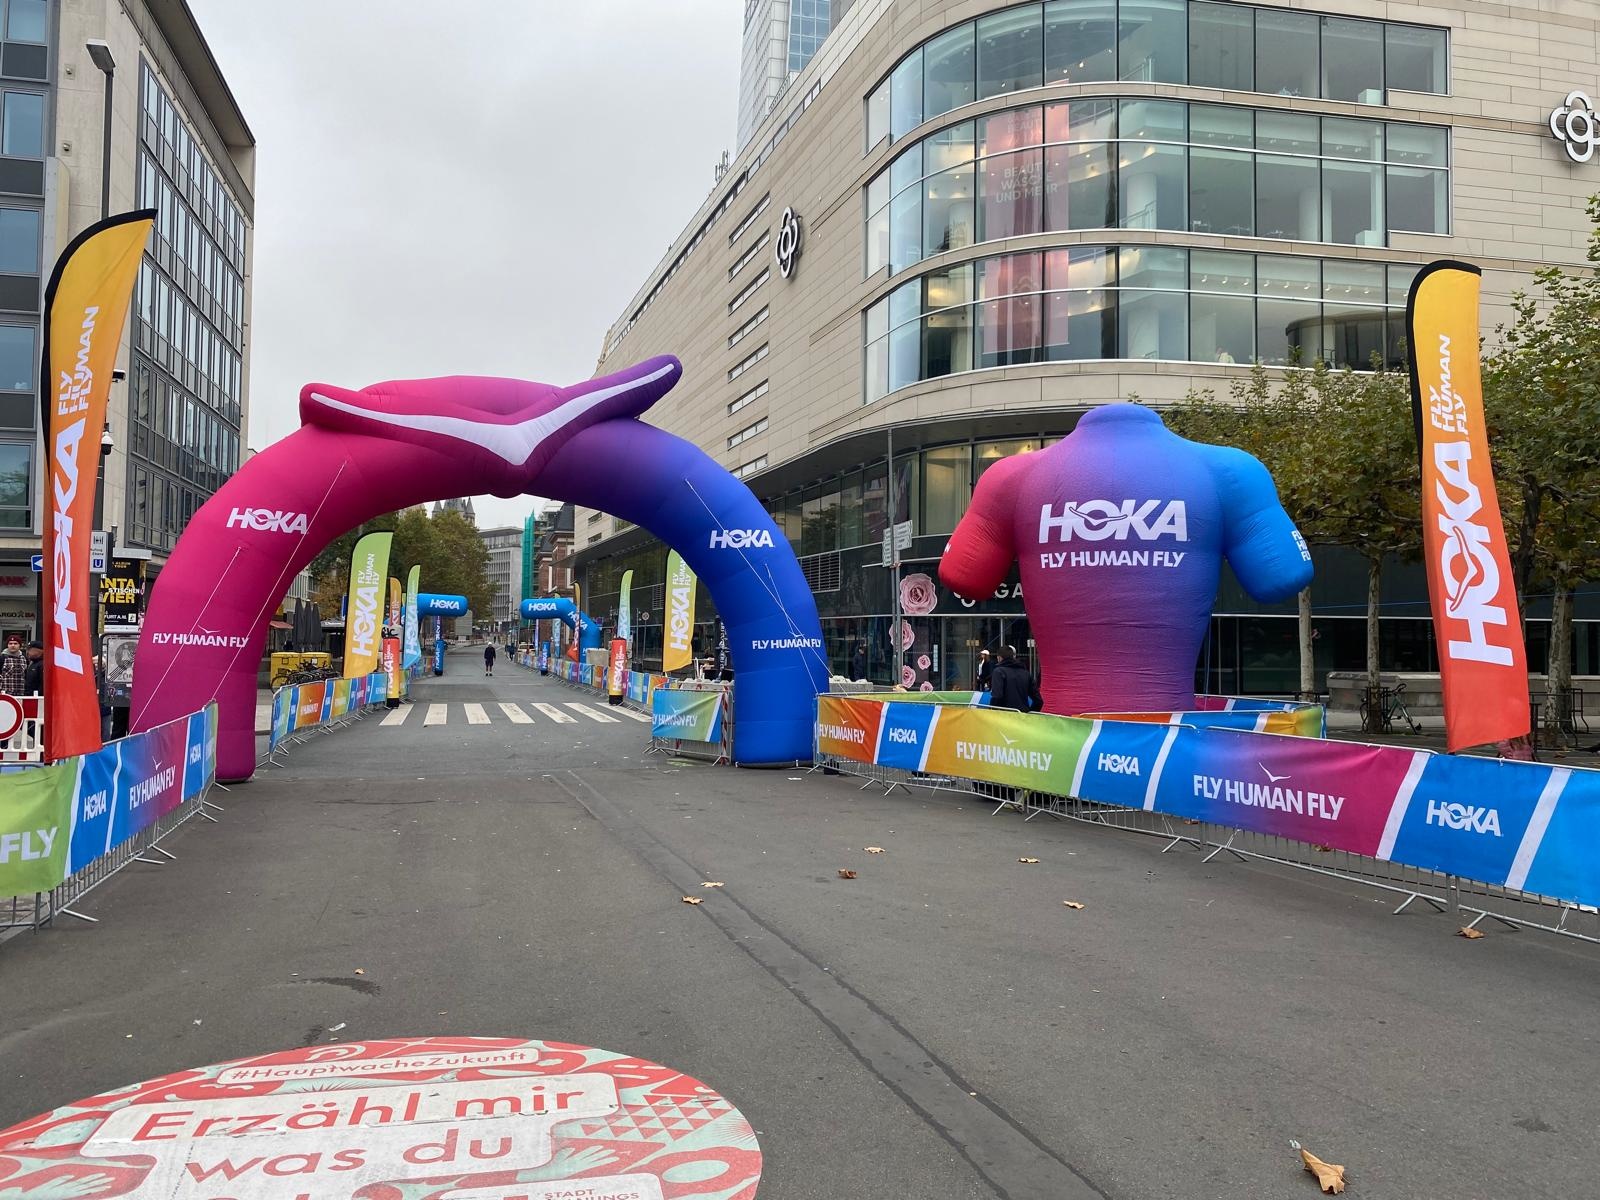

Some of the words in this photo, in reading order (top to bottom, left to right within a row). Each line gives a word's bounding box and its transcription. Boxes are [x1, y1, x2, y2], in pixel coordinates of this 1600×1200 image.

[1439, 334, 1455, 433] HUMAN
[1429, 384, 1443, 429] FLY
[1453, 392, 1469, 436] FLY
[226, 507, 308, 535] HOKA
[1039, 500, 1188, 544] HOKA
[54, 417, 86, 674] HOKA
[709, 529, 775, 549] HOKA
[1434, 441, 1514, 667] HOKA
[1040, 552, 1067, 569] FLY
[1071, 551, 1150, 568] HUMAN
[1153, 551, 1185, 568] FLY
[430, 599, 460, 610] HOKA
[528, 602, 558, 611] HOKA
[670, 587, 690, 650] HOKA
[352, 587, 378, 656] HOKA
[152, 633, 171, 644] FLY
[173, 634, 228, 648] HUMAN
[230, 637, 249, 648] FLY
[752, 640, 770, 650] FLY
[771, 639, 811, 649] HUMAN
[811, 639, 821, 648] FLY
[686, 714, 698, 727] FLY
[820, 724, 828, 738] FLY
[829, 725, 853, 743] HUMAN
[854, 729, 865, 744] FLY
[889, 728, 917, 744] HOKA
[956, 741, 977, 760] FLY
[979, 744, 1027, 768] HUMAN
[1030, 752, 1052, 771] FLY
[1098, 753, 1140, 776] HOKA
[129, 783, 141, 811] FLY
[141, 771, 165, 804] HUMAN
[166, 765, 176, 790] FLY
[1193, 775, 1222, 799] FLY
[1225, 779, 1304, 815] HUMAN
[1307, 791, 1346, 821] FLY
[84, 789, 107, 822] HOKA
[1425, 799, 1502, 837] HOKA
[0, 827, 58, 864] FLY
[232, 1051, 527, 1081] #HauptwacheZukunft
[132, 1092, 421, 1142] Erzähl
[455, 1085, 584, 1119] mir
[184, 1149, 367, 1184] was
[403, 1129, 513, 1165] du
[544, 1188, 595, 1199] STADT
